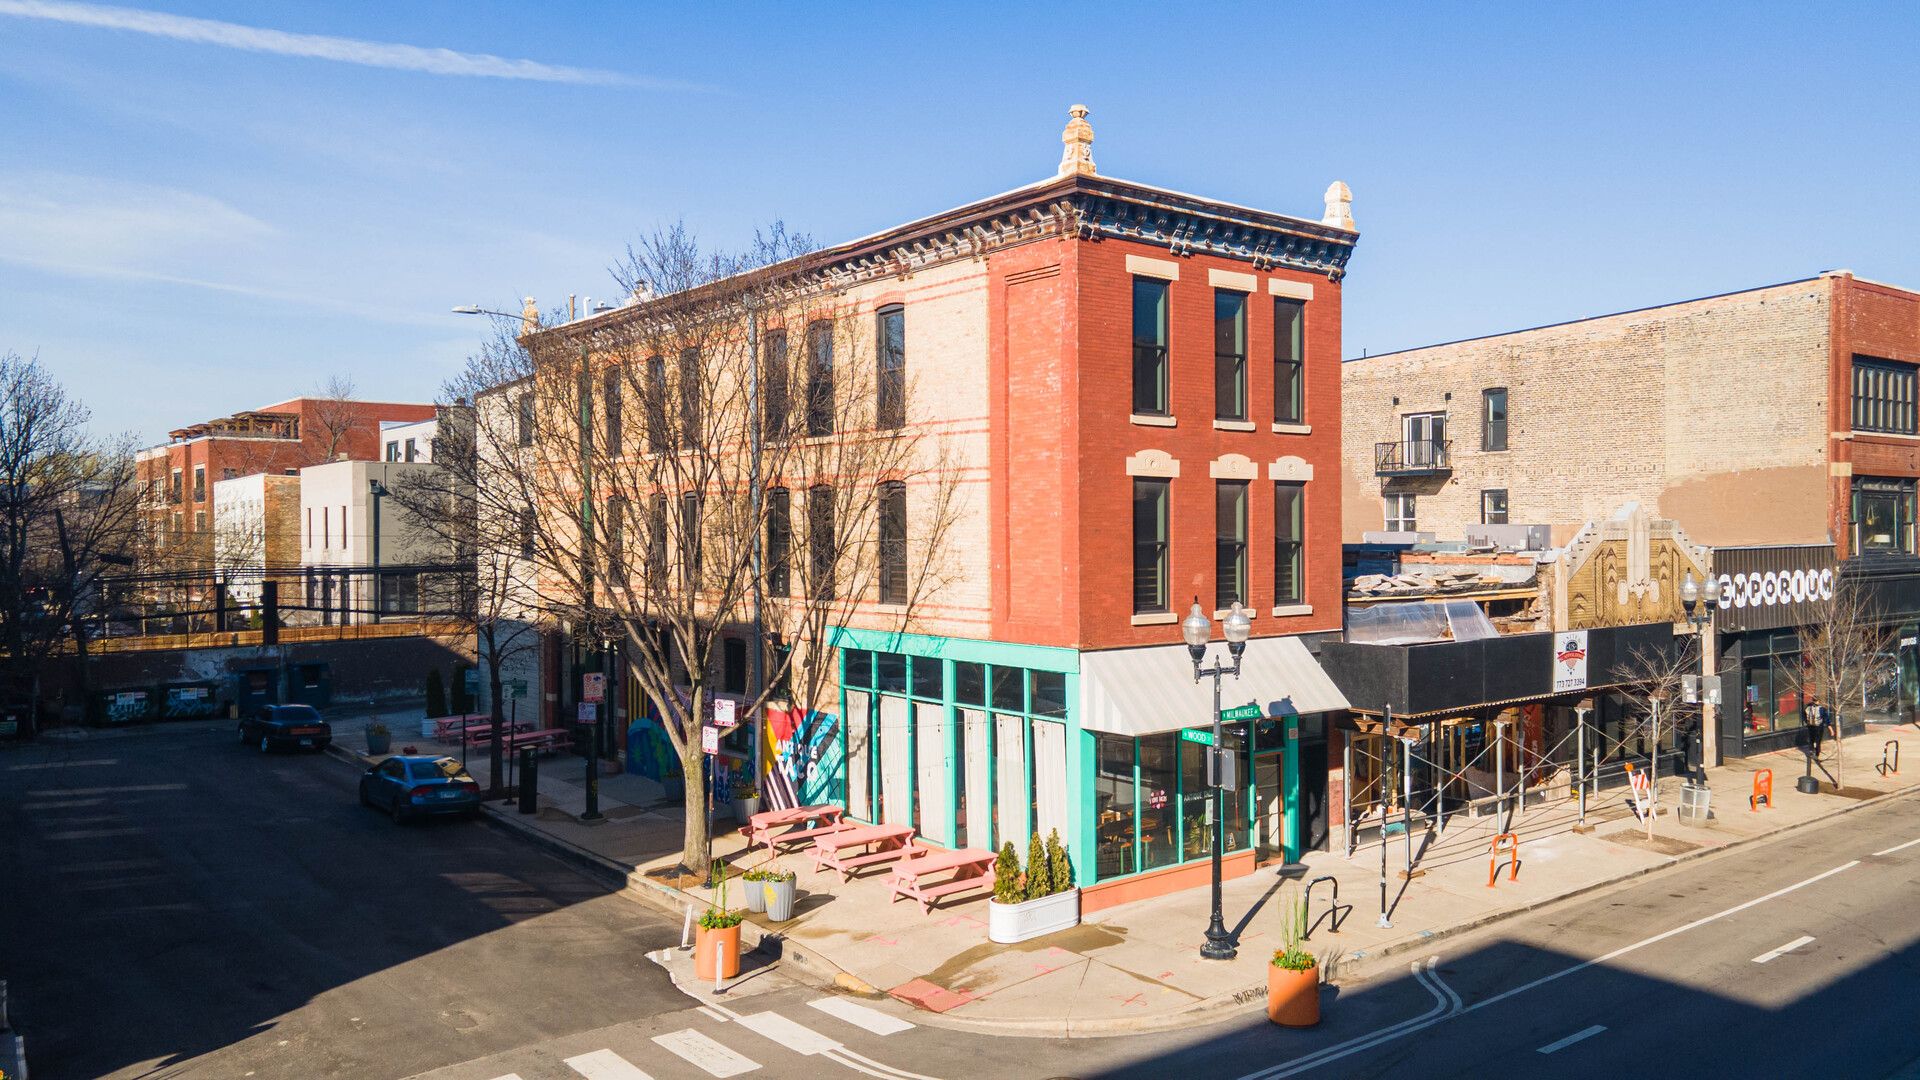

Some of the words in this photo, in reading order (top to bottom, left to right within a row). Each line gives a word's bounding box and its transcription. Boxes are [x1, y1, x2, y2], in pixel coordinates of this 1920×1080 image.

[1718, 570, 1832, 607] EMPORIUM
[1226, 707, 1253, 719] MILWAUKEE
[1187, 731, 1206, 742] WOOD
